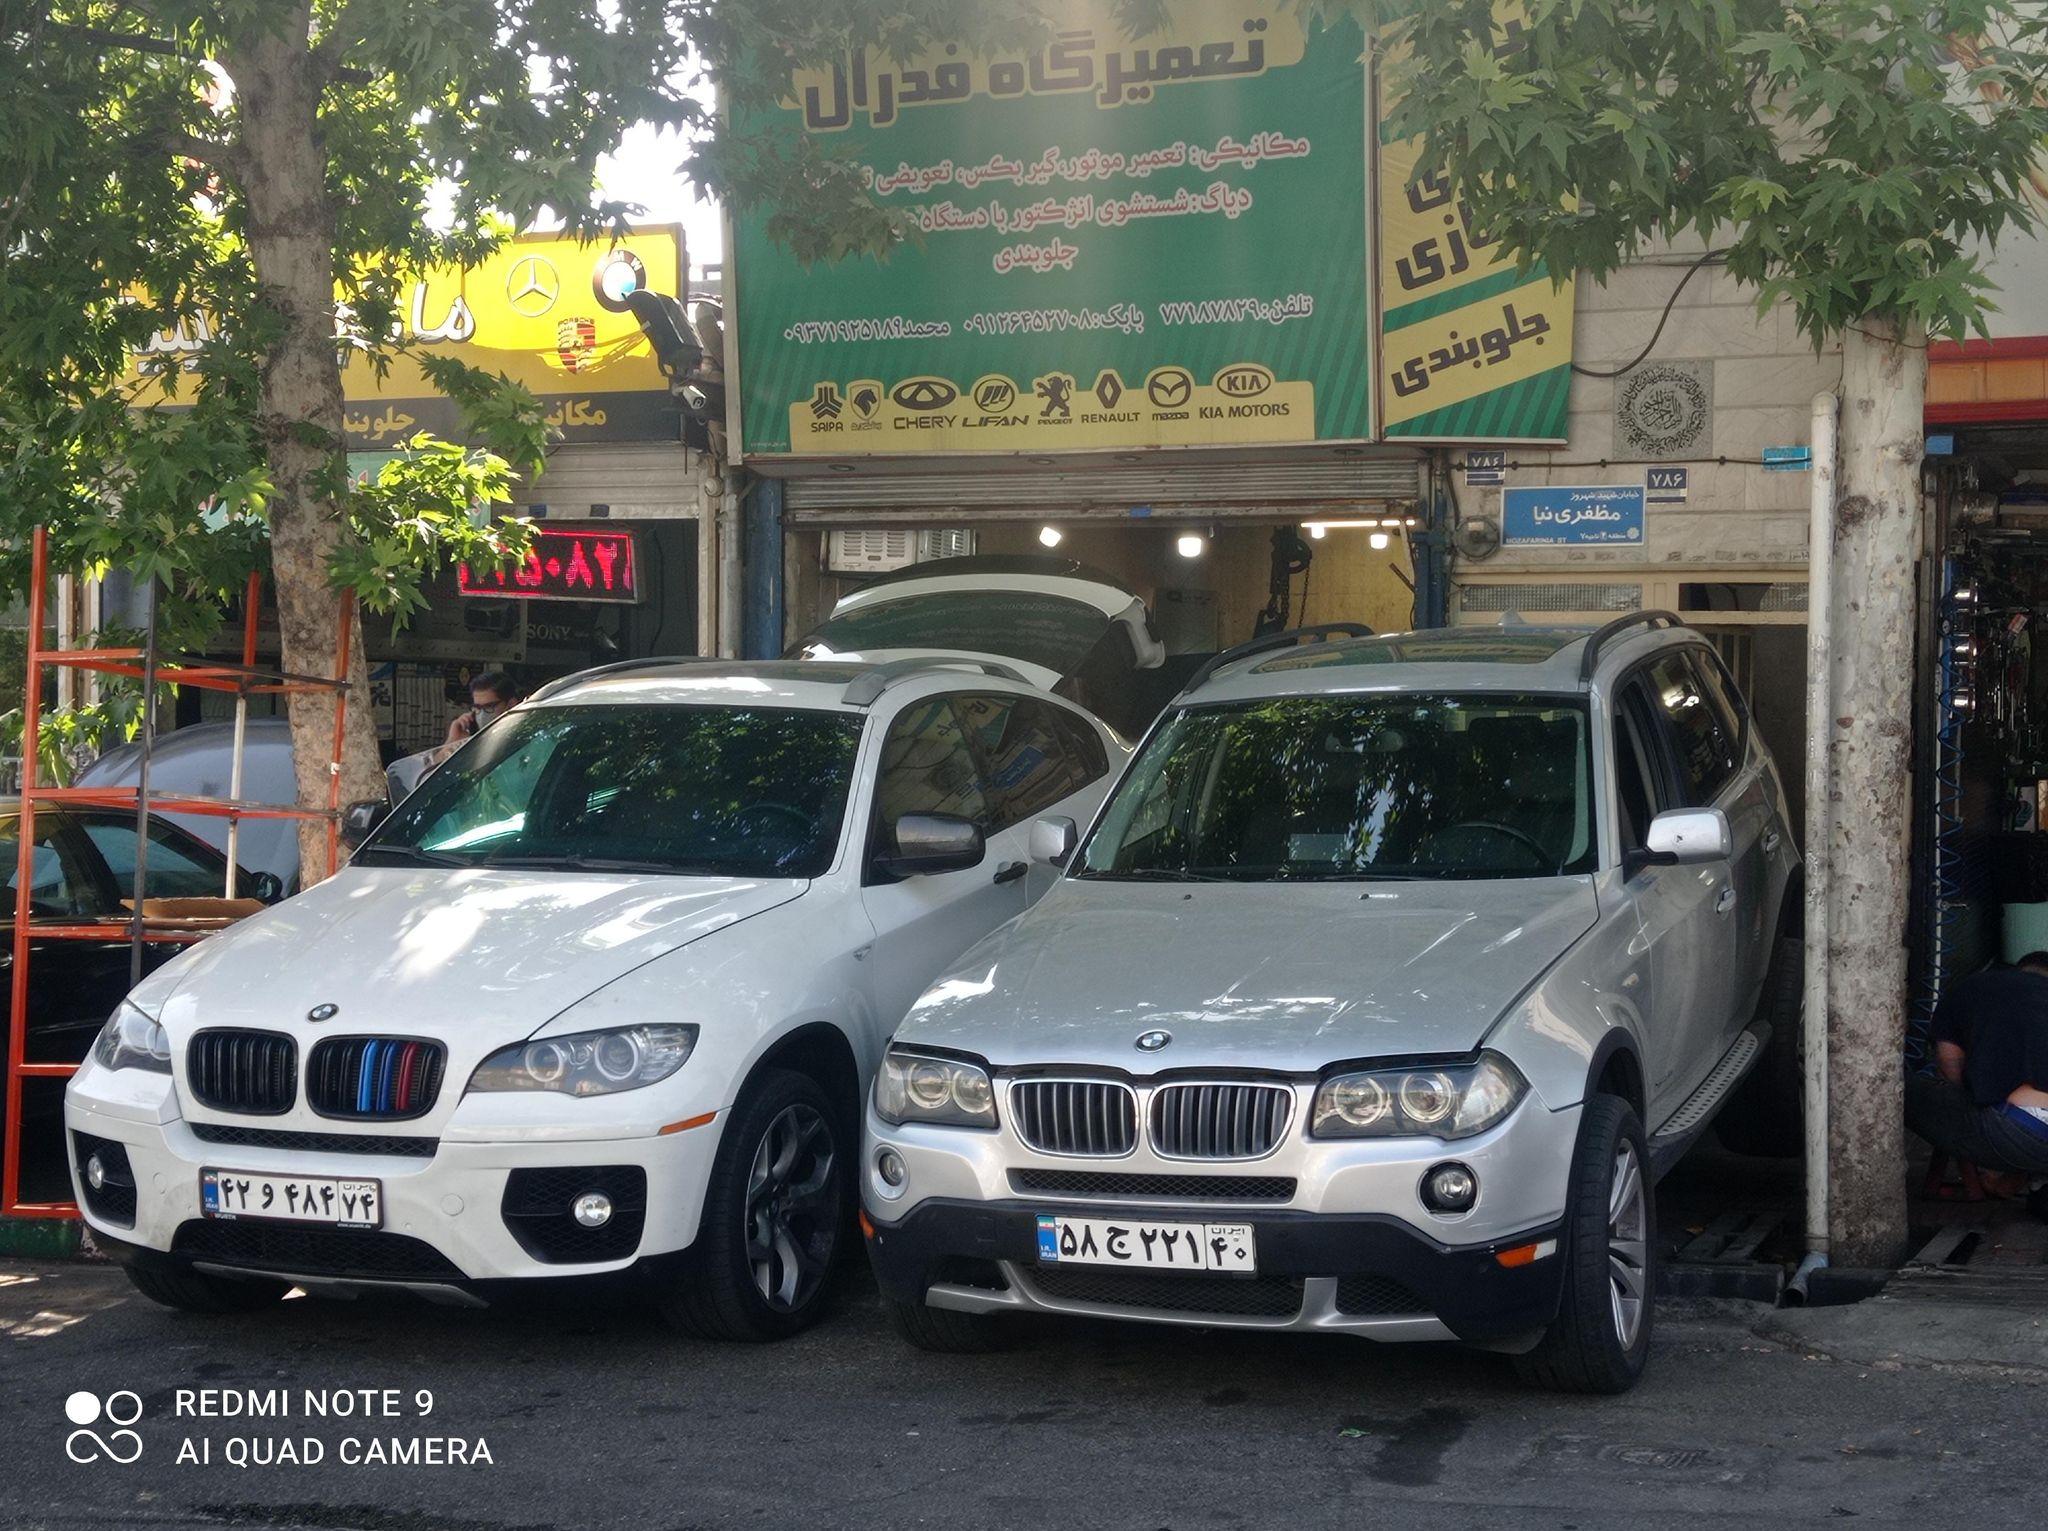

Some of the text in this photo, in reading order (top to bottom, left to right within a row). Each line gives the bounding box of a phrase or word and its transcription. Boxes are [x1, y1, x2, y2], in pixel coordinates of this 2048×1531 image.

[804, 18, 1268, 129] تعمیرگاه فدرال
[1126, 141, 1187, 178] تعمیر
[876, 160, 952, 195] تعویضی
[920, 201, 989, 233] دستگاه
[990, 200, 1008, 234] با
[1008, 194, 1094, 230] انژکتور
[993, 237, 1079, 273] جلوبندی
[1391, 304, 1551, 398] جلوبندی
[1081, 412, 1141, 424] RENAULT
[1199, 402, 1290, 420] KIA MOTORS
[811, 421, 844, 433] SAIPA
[893, 415, 957, 430] CHERY
[961, 415, 1030, 428] LIFAN
[1037, 418, 1073, 426] PEUGEOT
[1651, 473, 1683, 487] ۷۸۶
[1533, 505, 1621, 525] مظفری نیا
[527, 625, 572, 641] SONY
